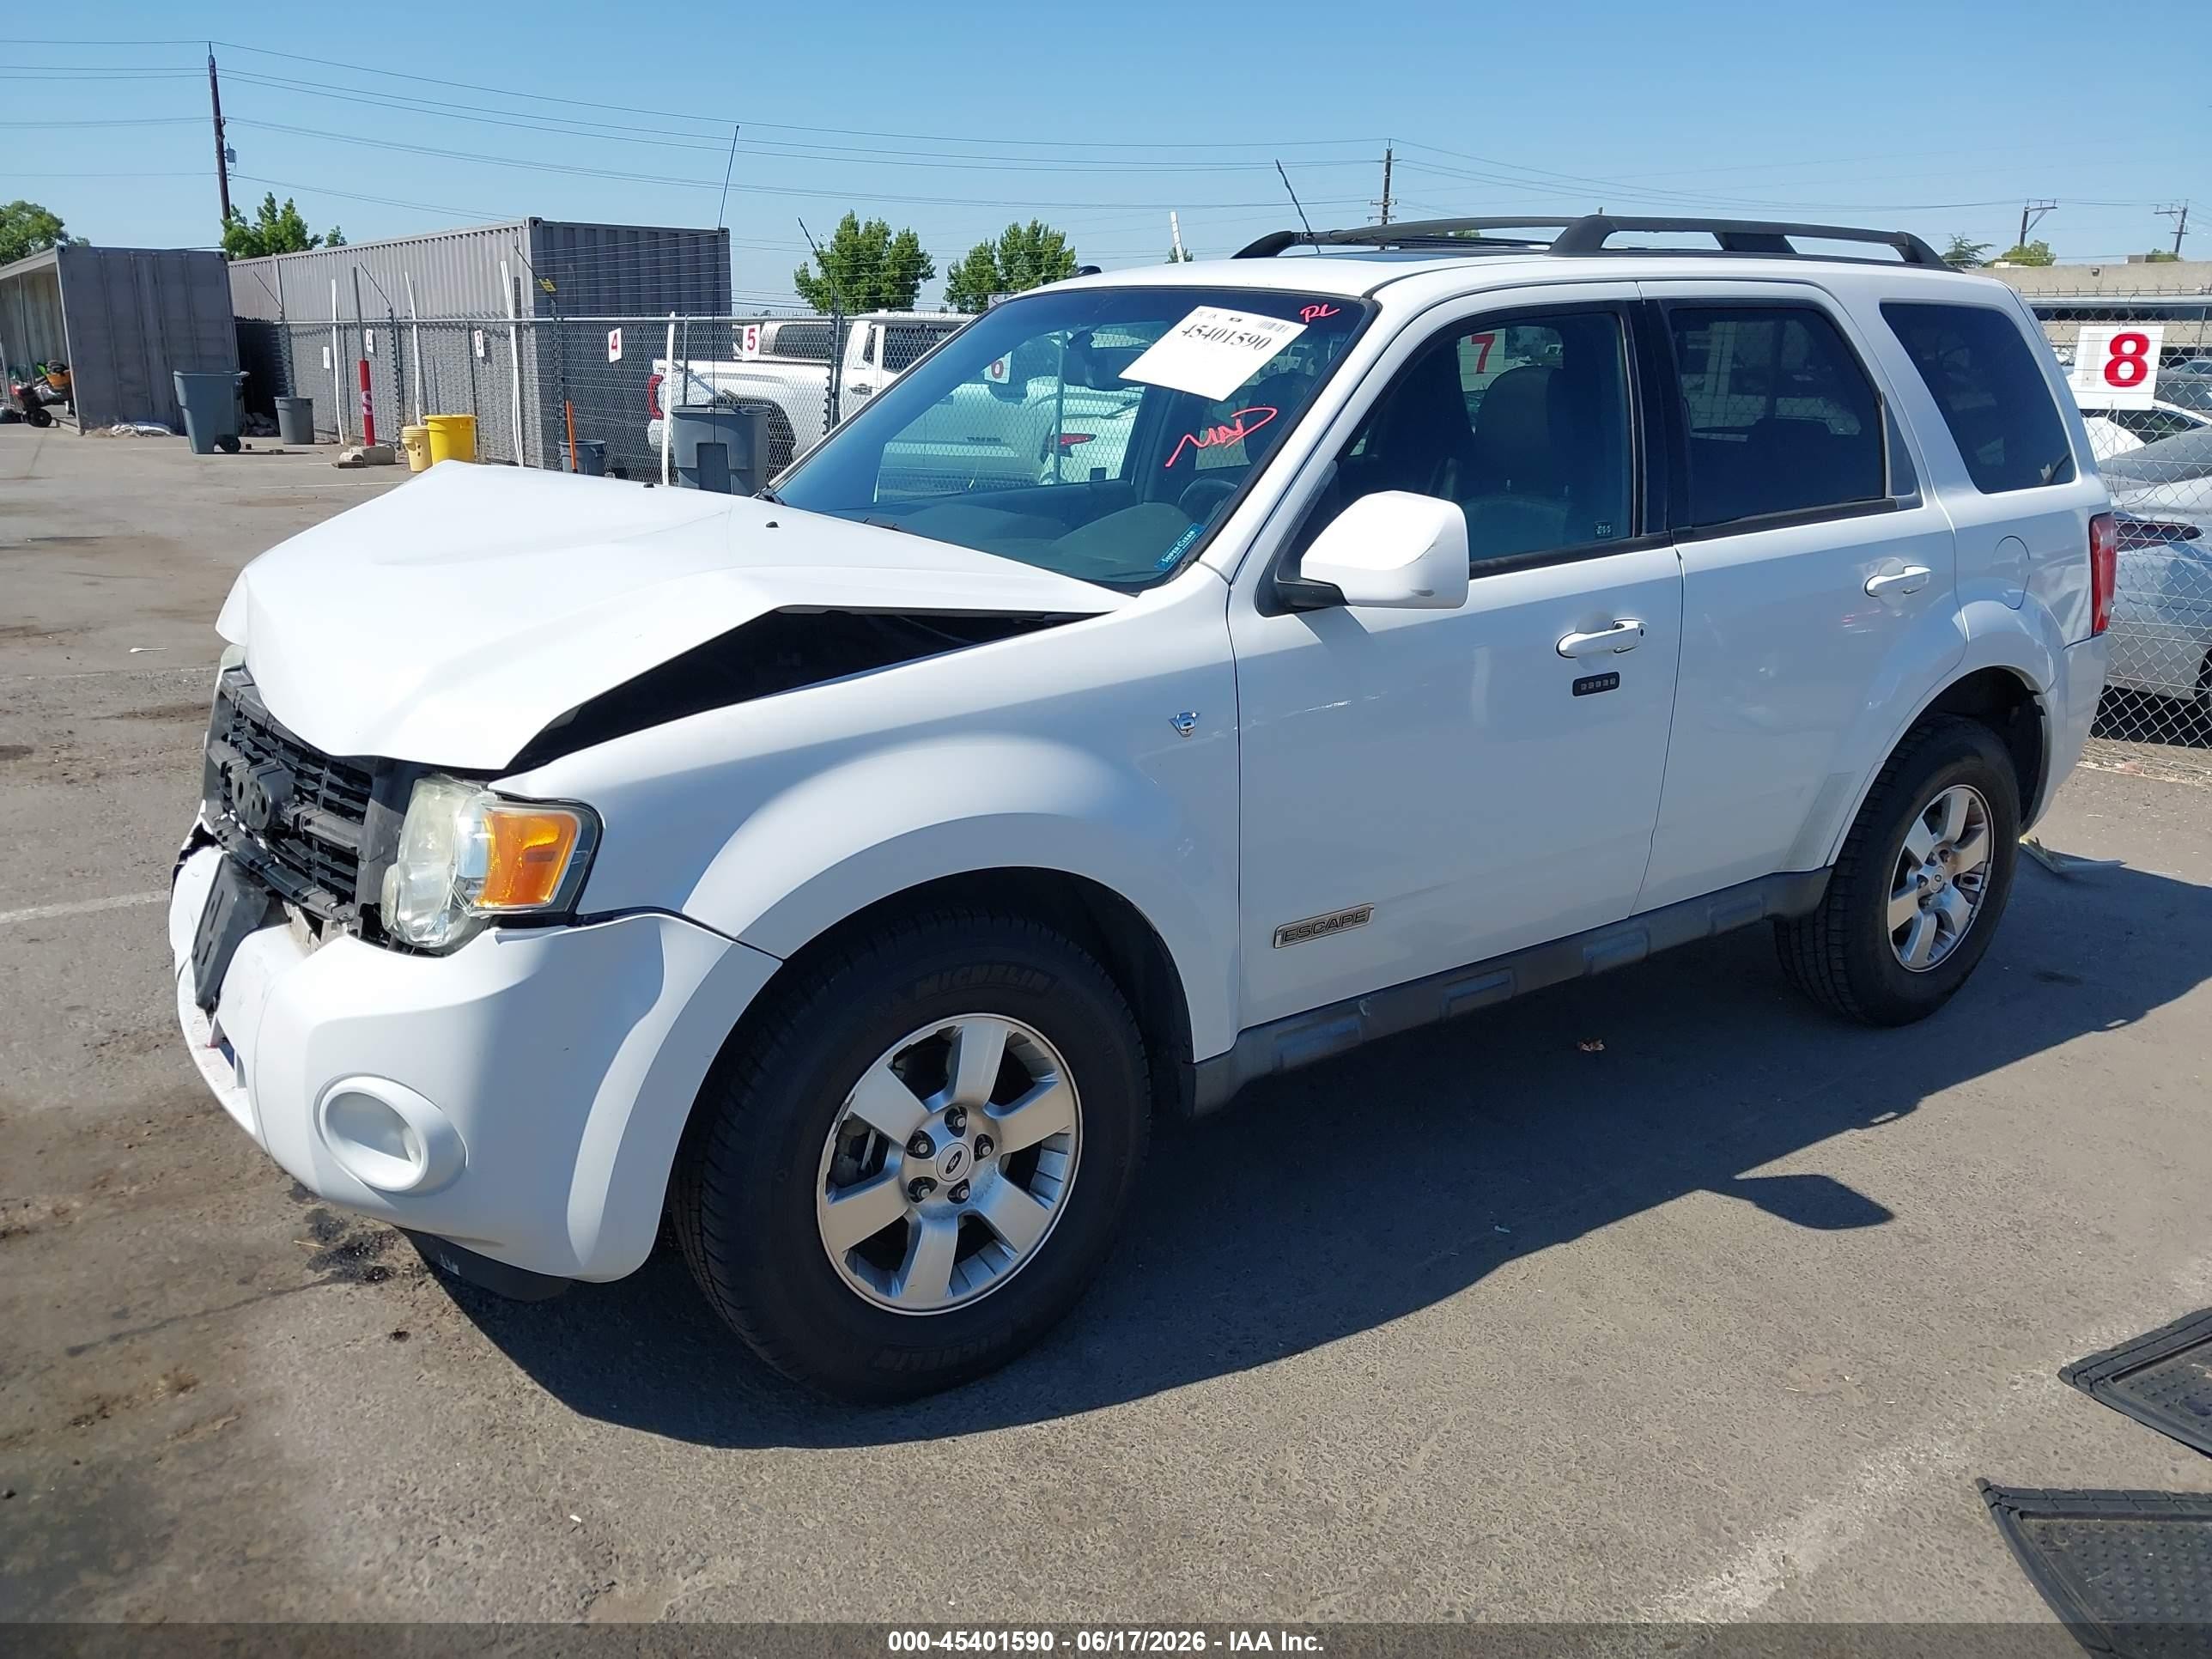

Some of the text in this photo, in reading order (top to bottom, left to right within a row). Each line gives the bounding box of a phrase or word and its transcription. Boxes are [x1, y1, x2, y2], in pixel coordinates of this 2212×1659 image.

[611, 332, 618, 352] 4
[746, 328, 757, 350] 5
[1181, 323, 1272, 351] 45401590
[1471, 333, 1496, 374] 7
[2104, 332, 2150, 387] 8
[1284, 909, 1369, 942] ESCAPE
